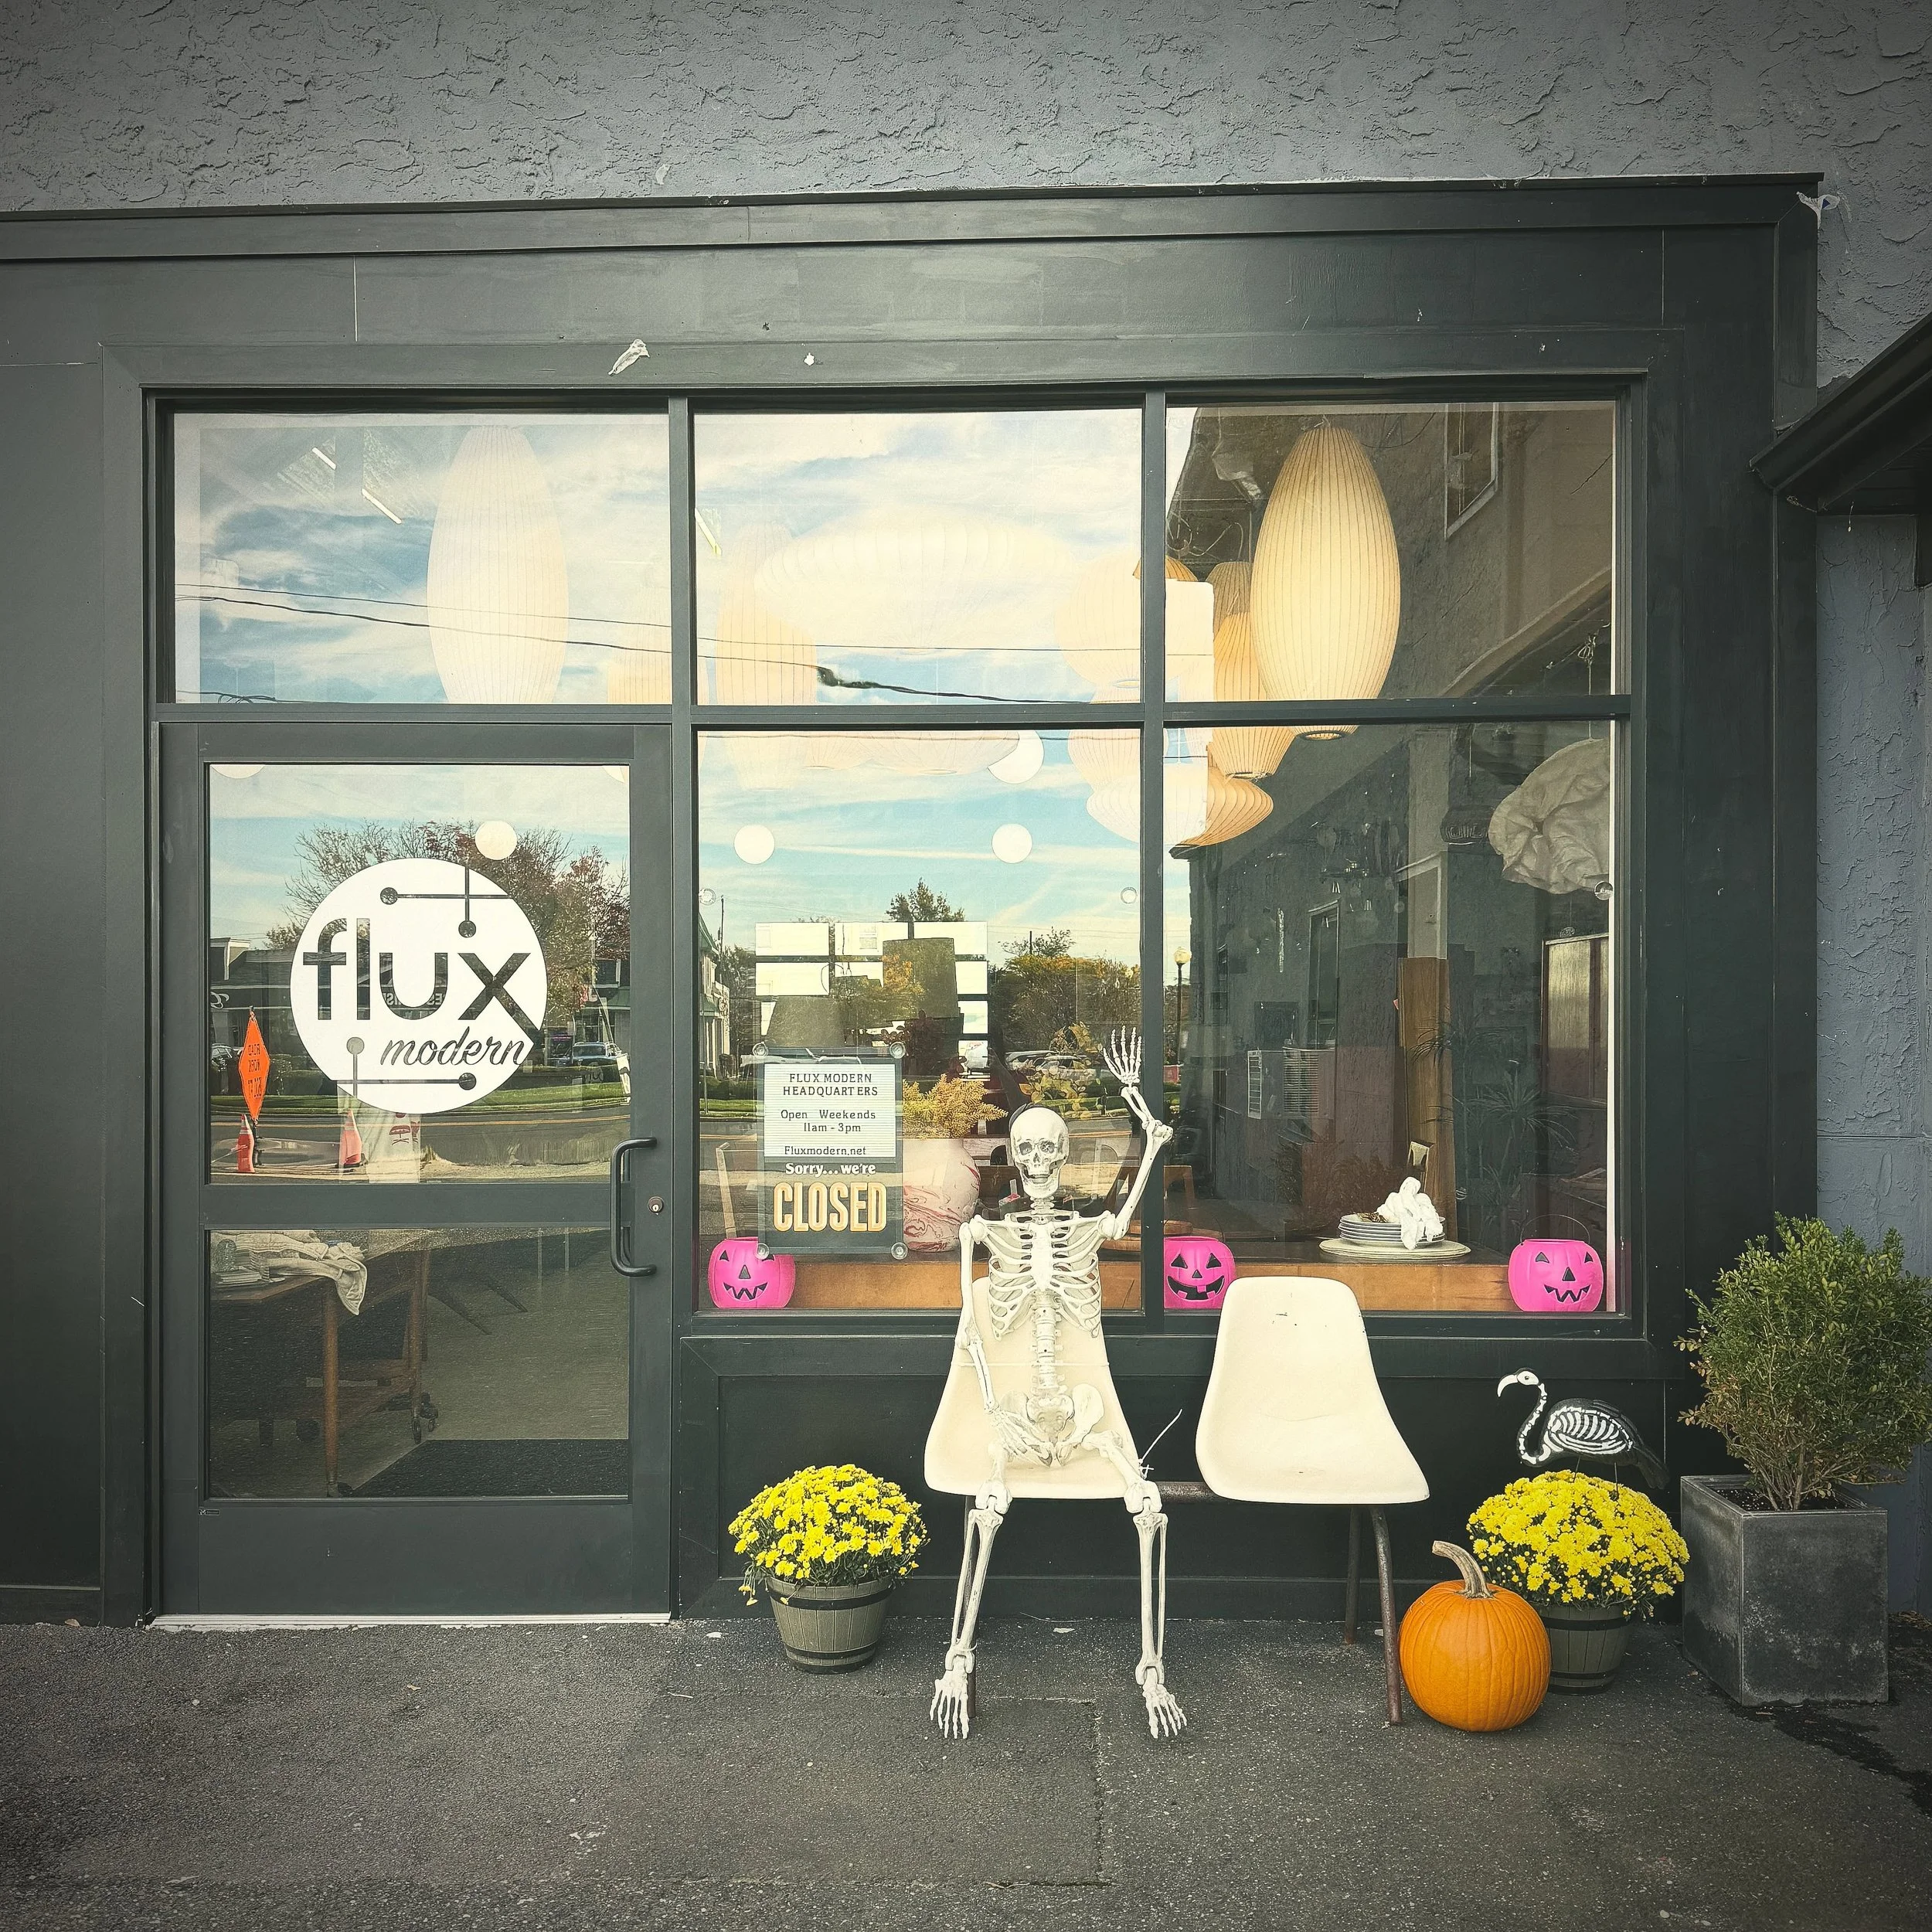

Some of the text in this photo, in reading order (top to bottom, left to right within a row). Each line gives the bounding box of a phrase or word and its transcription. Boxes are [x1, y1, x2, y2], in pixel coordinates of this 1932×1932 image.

[302, 917, 539, 1031] flux
[379, 1026, 528, 1066] modern
[789, 1073, 872, 1083] FLUX MODERN
[783, 1086, 878, 1096] HEADQUARTERS
[781, 1108, 876, 1121] Open Weekends
[838, 1122, 861, 1134] 3pm
[784, 1146, 866, 1156] Fluxmodern.net
[840, 1162, 876, 1175] we're
[774, 1182, 887, 1232] CLOSED
